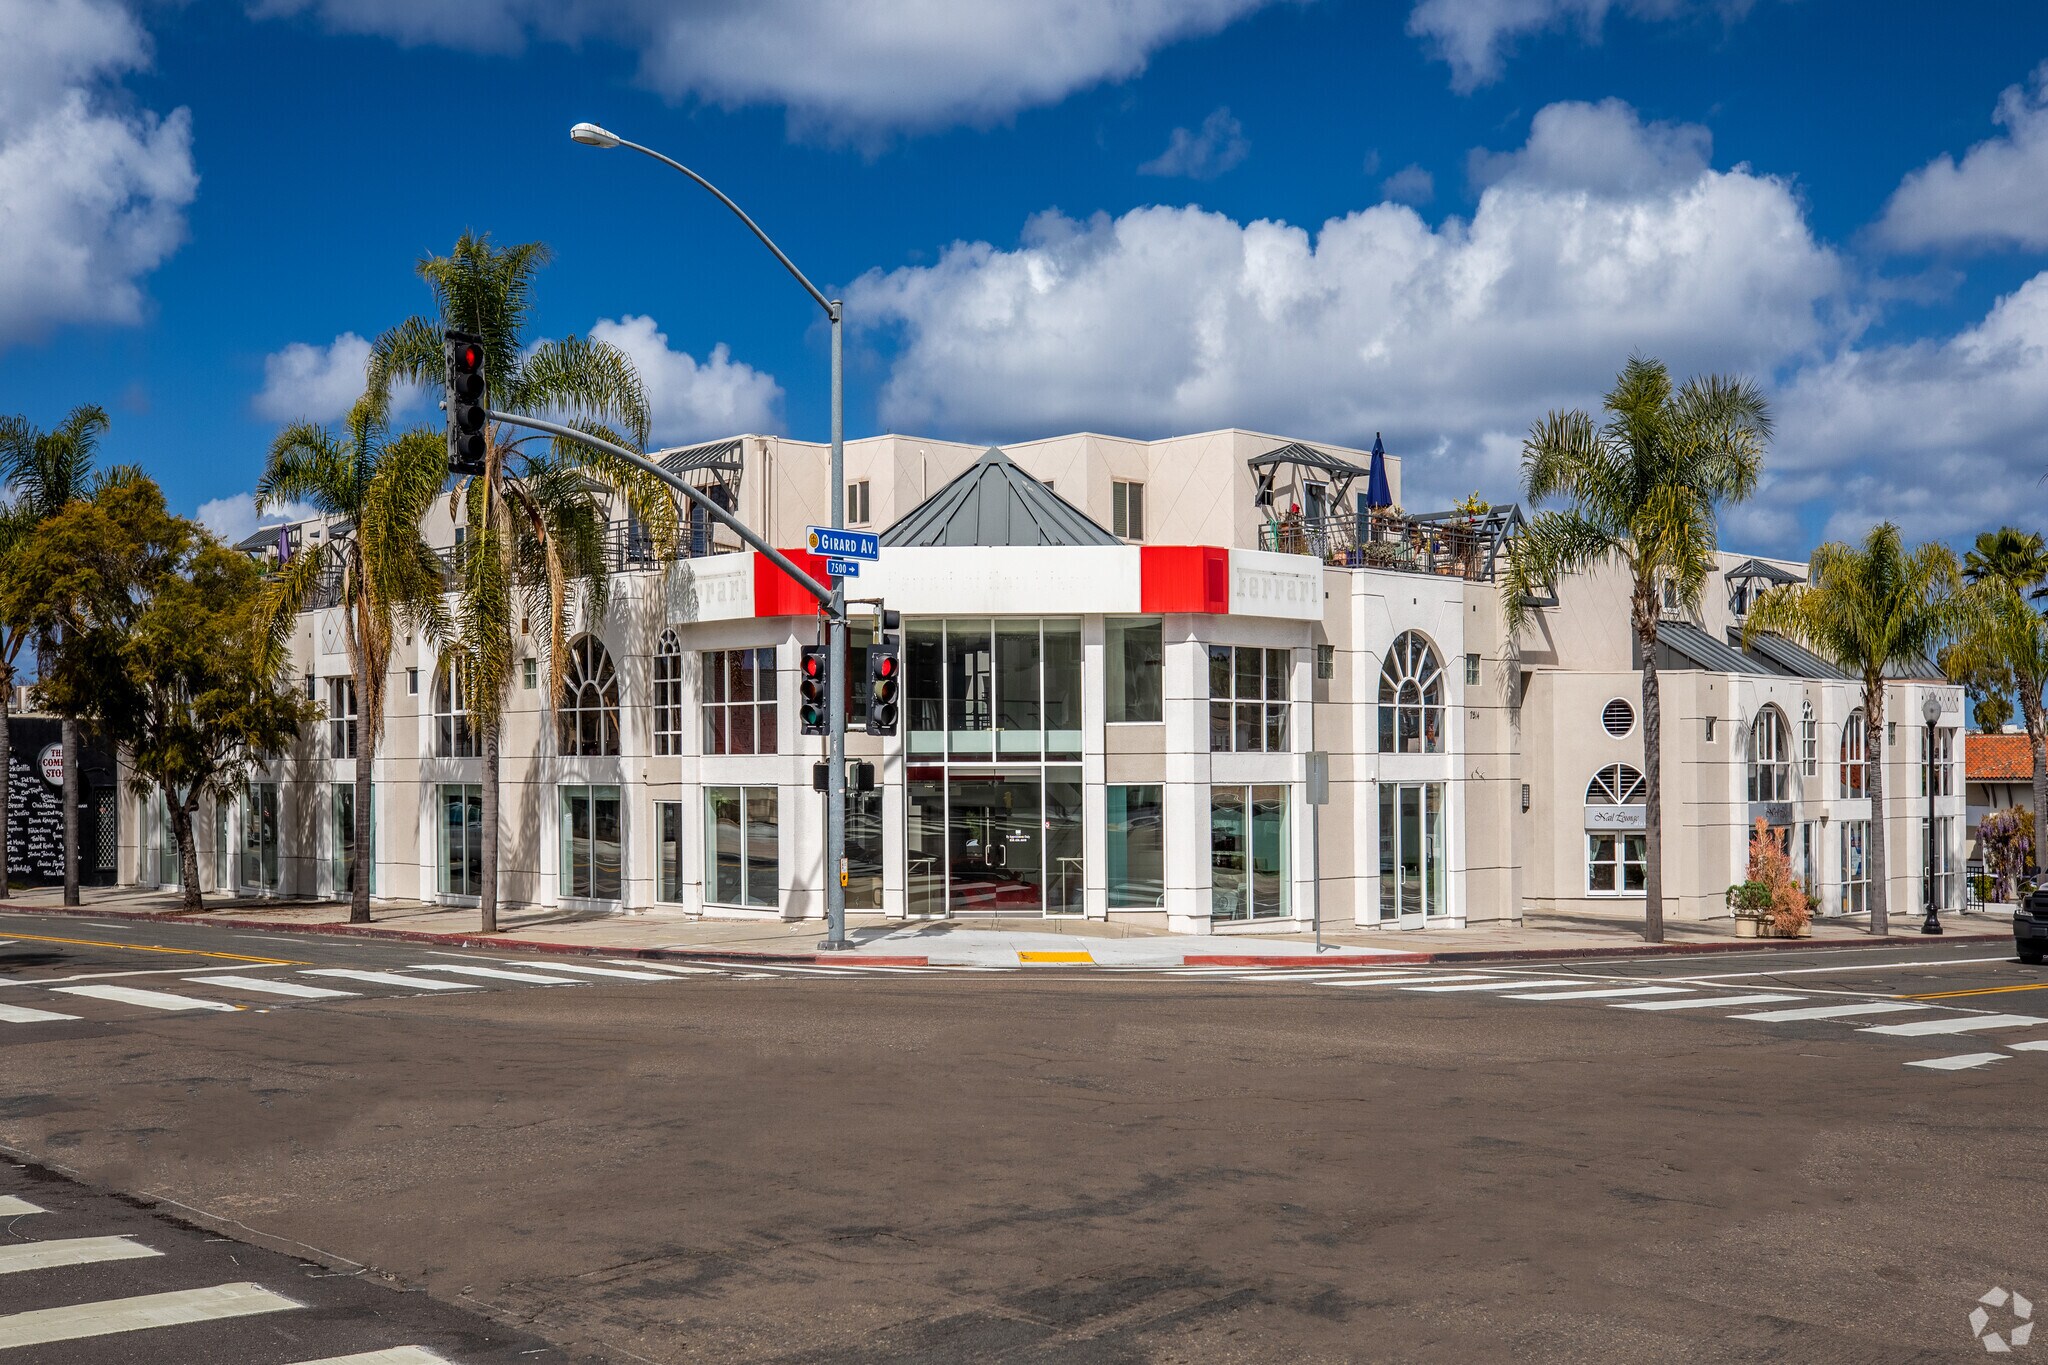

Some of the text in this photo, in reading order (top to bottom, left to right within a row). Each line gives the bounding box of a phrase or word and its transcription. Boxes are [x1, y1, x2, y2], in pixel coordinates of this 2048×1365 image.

[821, 534, 876, 554] GIRARD AV.
[831, 562, 847, 573] 7500
[51, 749, 63, 757] TH
[45, 768, 63, 778] STO
[1594, 811, 1615, 822] Nail
[1616, 811, 1640, 824] Lounge
